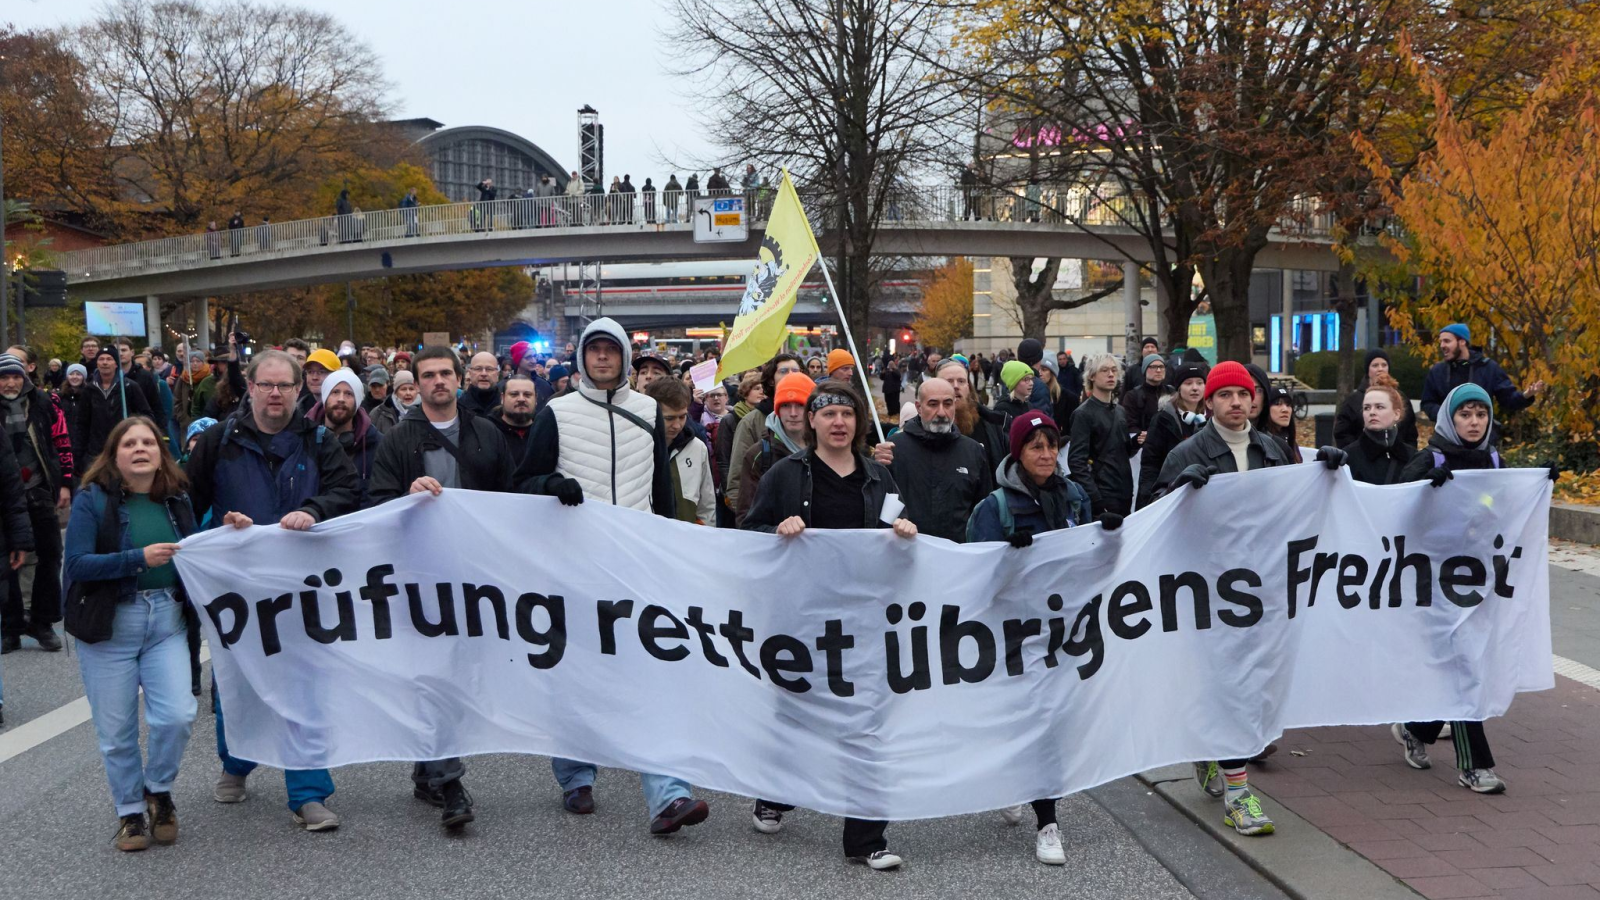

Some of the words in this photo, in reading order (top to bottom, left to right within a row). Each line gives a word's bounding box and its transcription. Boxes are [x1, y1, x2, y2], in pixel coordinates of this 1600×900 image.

[597, 598, 856, 697] rettet
[885, 569, 1264, 695] übrigens
[1287, 532, 1523, 620] Freiheit
